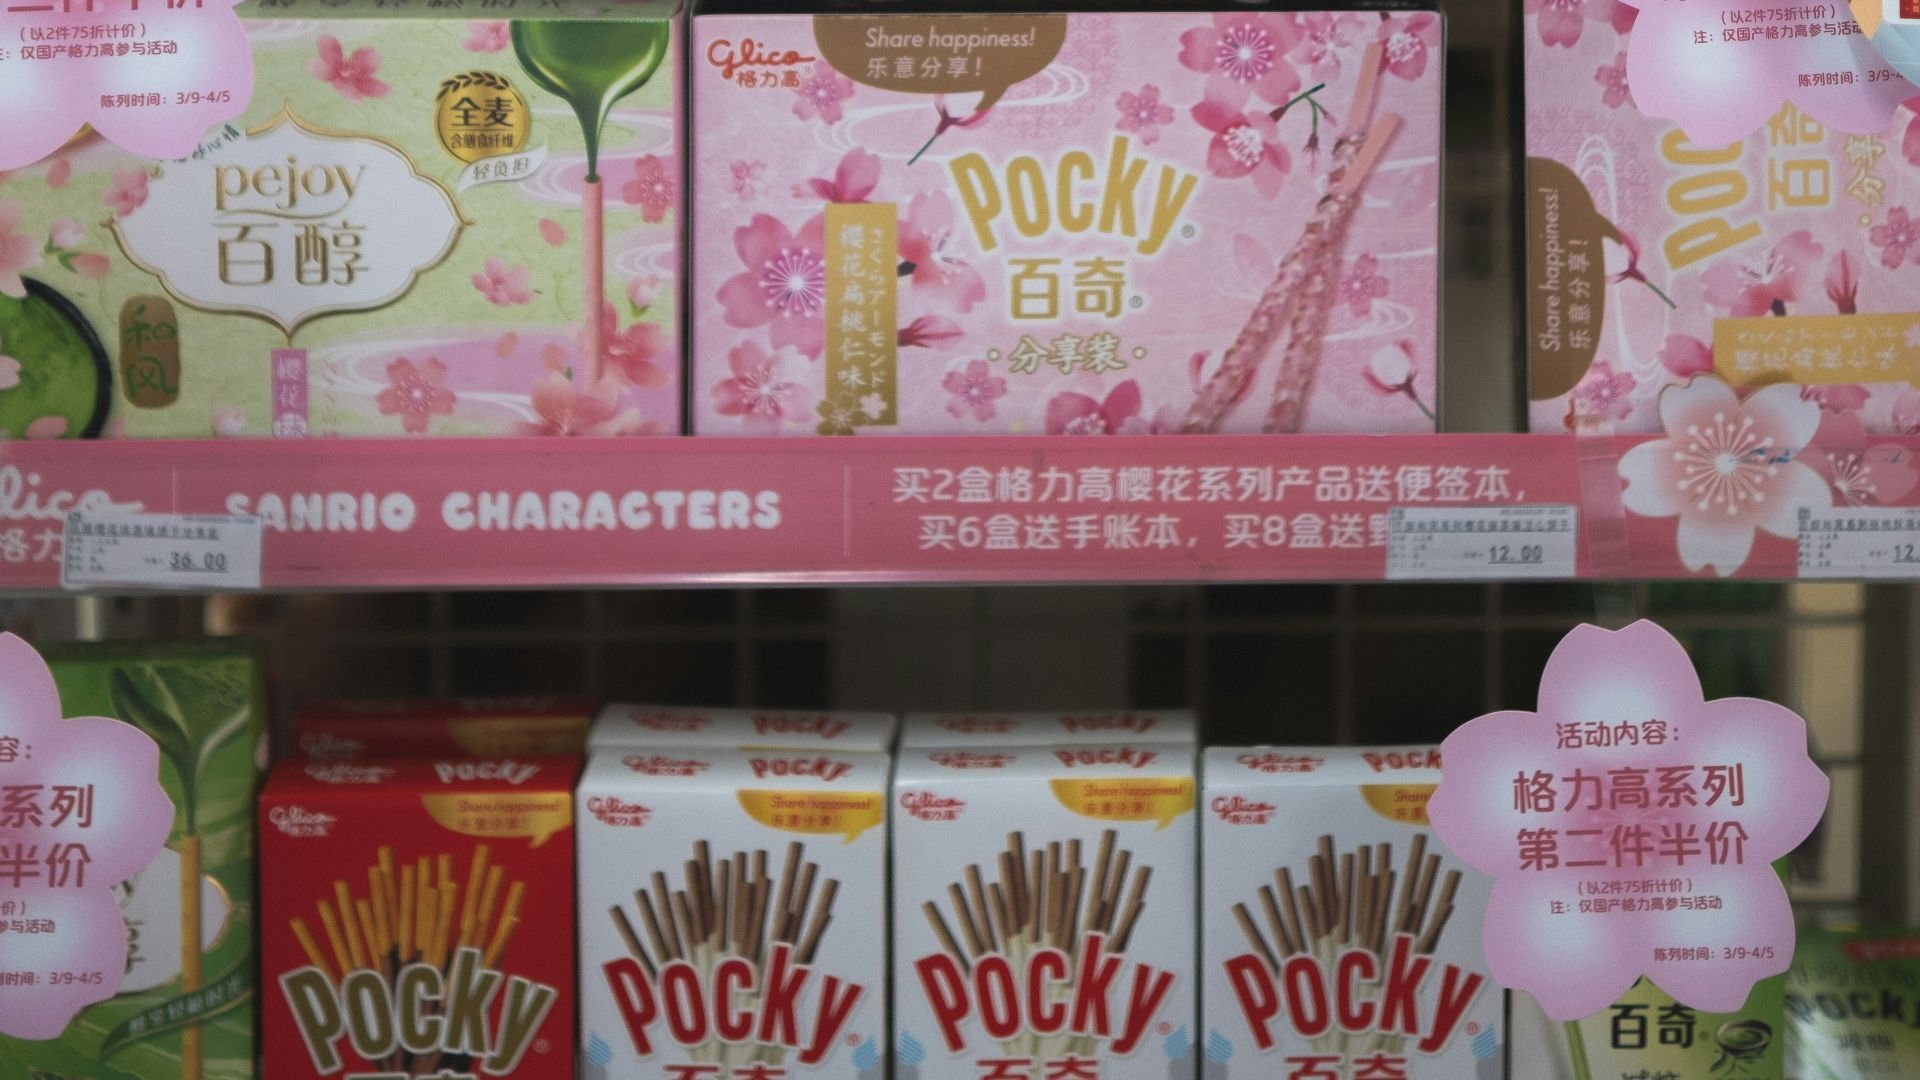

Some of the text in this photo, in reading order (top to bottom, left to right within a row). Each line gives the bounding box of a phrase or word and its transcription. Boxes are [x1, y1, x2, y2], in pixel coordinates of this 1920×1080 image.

[19, 23, 147, 42] （以2件75折计价）
[1721, 5, 1836, 25] （以2件75折计价）
[707, 38, 815, 81] Glico
[865, 26, 1036, 53] Share happiness!
[736, 70, 800, 88] 格力高
[866, 56, 982, 79] 乐意分享！
[100, 91, 231, 109] 陈列时间：3/9-4/5
[451, 97, 514, 127] 全麦
[213, 153, 368, 219] pejoy
[949, 135, 1198, 255] Pocky
[213, 220, 369, 287] 百醇
[1537, 187, 1565, 351] Share happiness!
[1007, 256, 1125, 320] 百奇
[1568, 239, 1590, 349] 乐意分享！
[1008, 332, 1128, 375] 分享装
[892, 465, 1525, 503] 买2盒格力高樱花系列产品送便签本，
[226, 492, 414, 532] SANRIO
[441, 490, 781, 530] CHARACTERS
[170, 551, 226, 570] 36.00
[1489, 543, 1543, 563] 12.00
[1556, 718, 1680, 750] 活动内容：
[1512, 762, 1746, 814] 格力高系列
[1516, 820, 1749, 872] 第二件半价
[1577, 878, 1693, 896] （以2件75折计价）
[0, 900, 27, 917] 价）
[1653, 946, 1776, 962] 陈列时间：3/9-4/5
[0, 970, 104, 987] 时间：3/9-4/5
[914, 932, 1177, 1055] Pocky
[1222, 933, 1485, 1056] Pocky
[279, 947, 560, 1077] Pocky
[602, 941, 864, 1064] Pocky
[1609, 1003, 1697, 1050] 百奇
